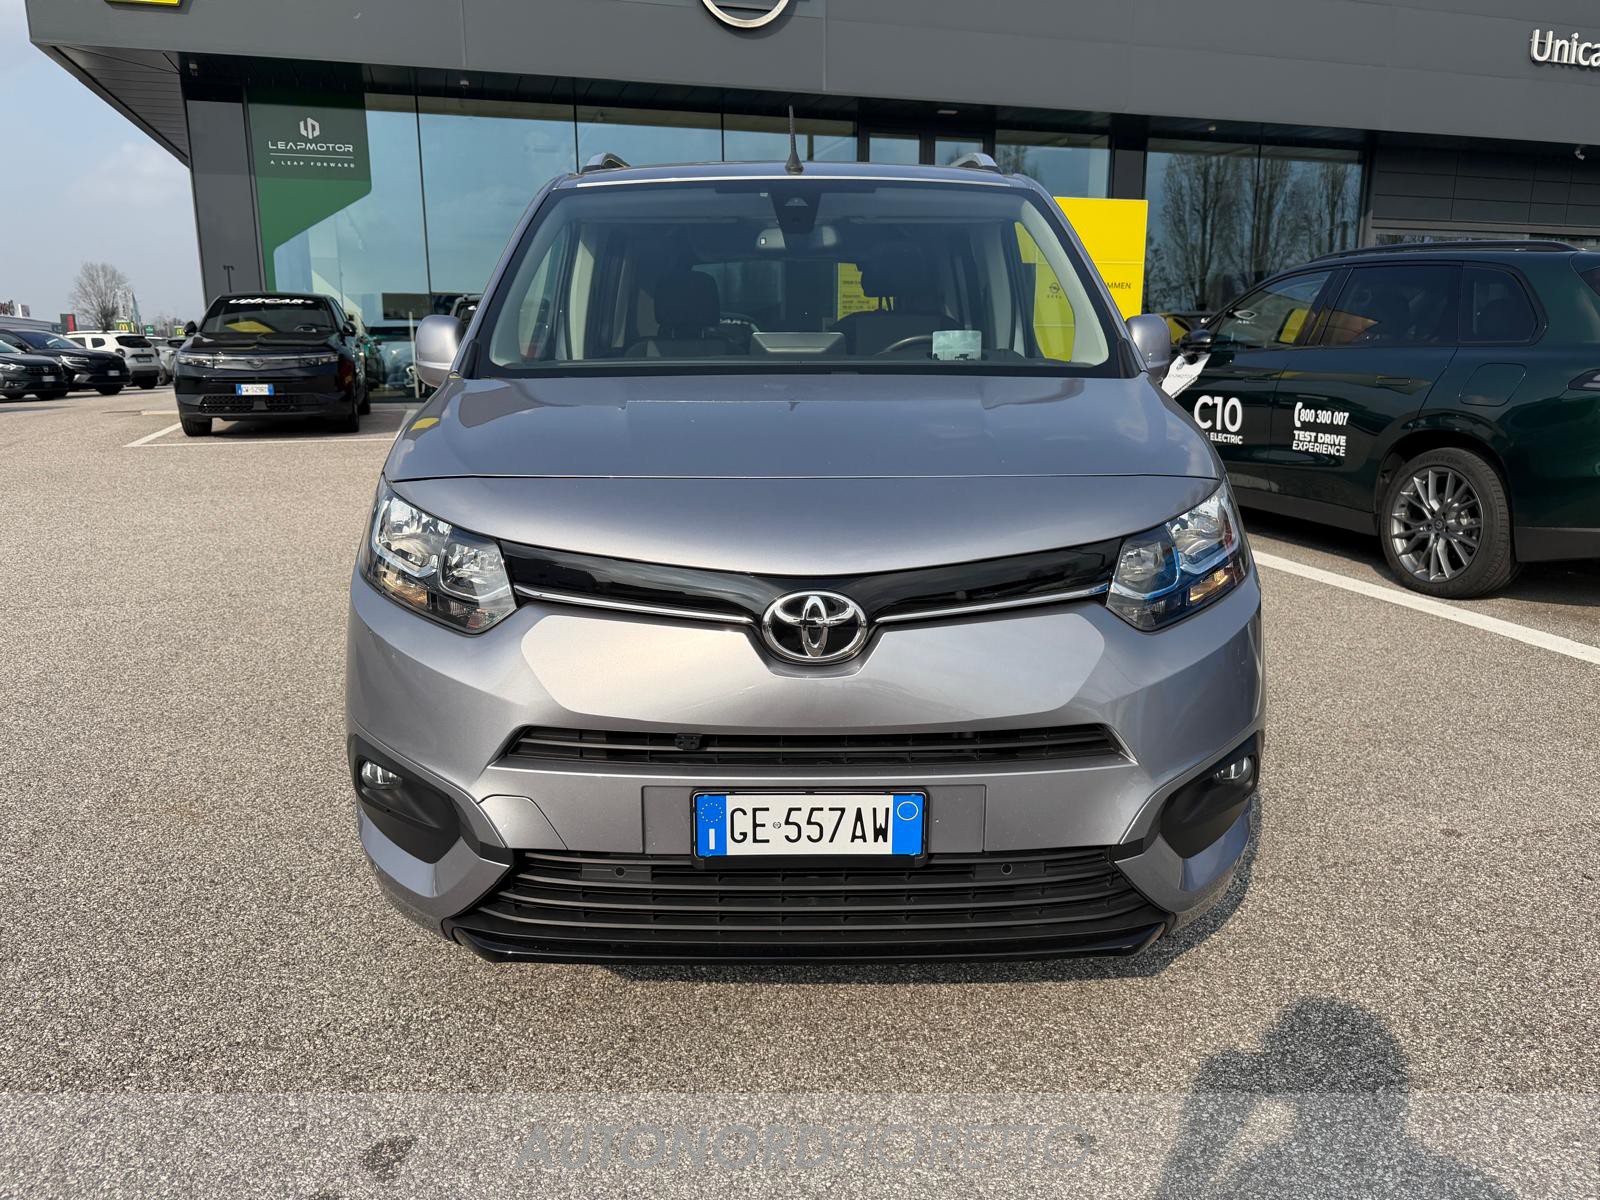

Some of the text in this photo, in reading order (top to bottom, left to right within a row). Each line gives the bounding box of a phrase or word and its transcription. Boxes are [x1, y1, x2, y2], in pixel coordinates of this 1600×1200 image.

[268, 141, 353, 152] LEAPMOTOR
[1194, 395, 1243, 432] C10
[1300, 408, 1349, 425] 800 300 007
[1210, 432, 1243, 444] ELECTRIC
[1293, 430, 1346, 446] TEST DRIVE
[1292, 440, 1346, 457] EXPERIENCE
